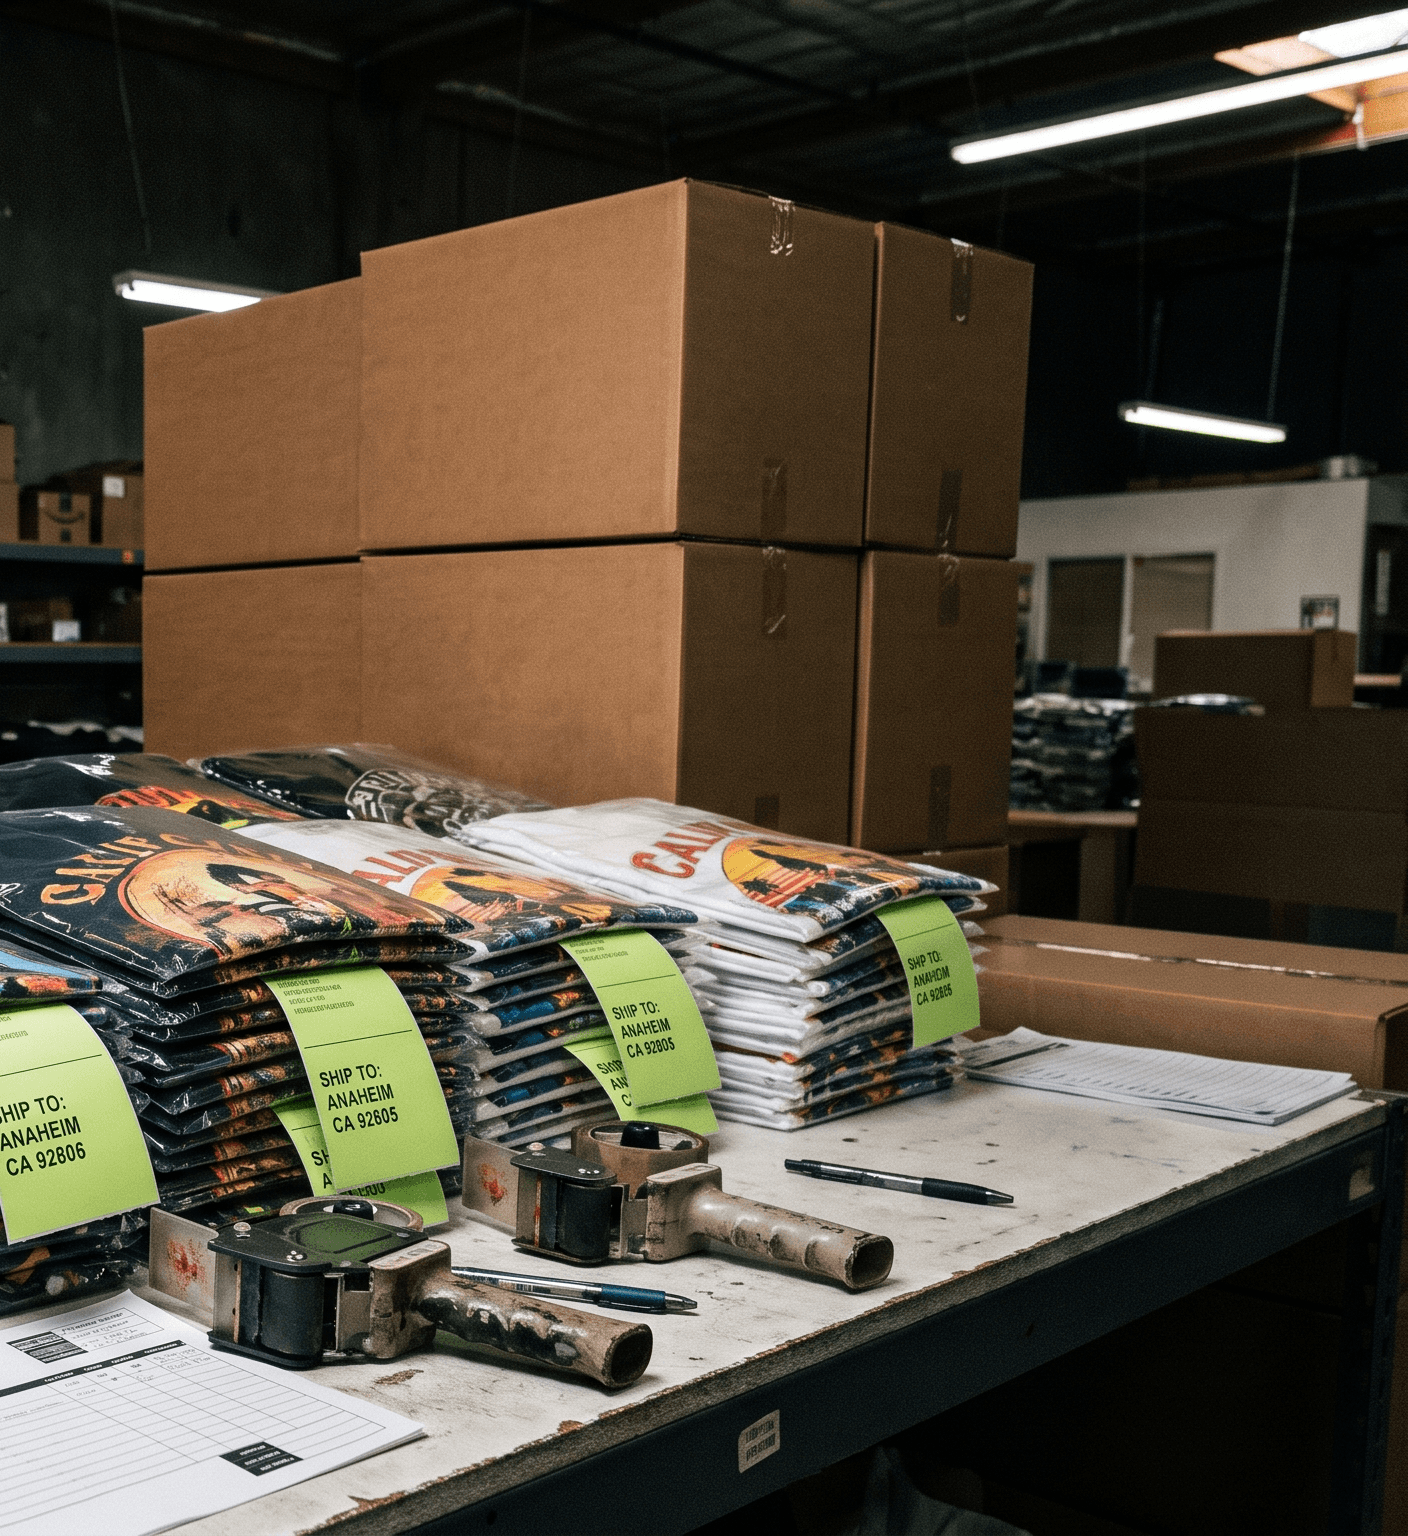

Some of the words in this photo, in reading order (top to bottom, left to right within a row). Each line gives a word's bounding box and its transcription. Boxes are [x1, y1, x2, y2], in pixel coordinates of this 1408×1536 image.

[917, 991, 929, 1006] CA
[612, 1004, 638, 1020] SHIP
[639, 1001, 661, 1016] TO:
[621, 1017, 672, 1039] ANAHEIM
[626, 1044, 644, 1058] CA
[645, 1036, 676, 1056] 92805
[319, 1067, 353, 1088] SHIP
[355, 1063, 382, 1081] TO:
[34, 1094, 67, 1115] TO:
[328, 1083, 394, 1111] ANAHEIM
[0, 1116, 82, 1152] ANAHEIM
[332, 1115, 356, 1133] CA
[5, 1155, 34, 1176] CA
[36, 1141, 87, 1170] 92806
